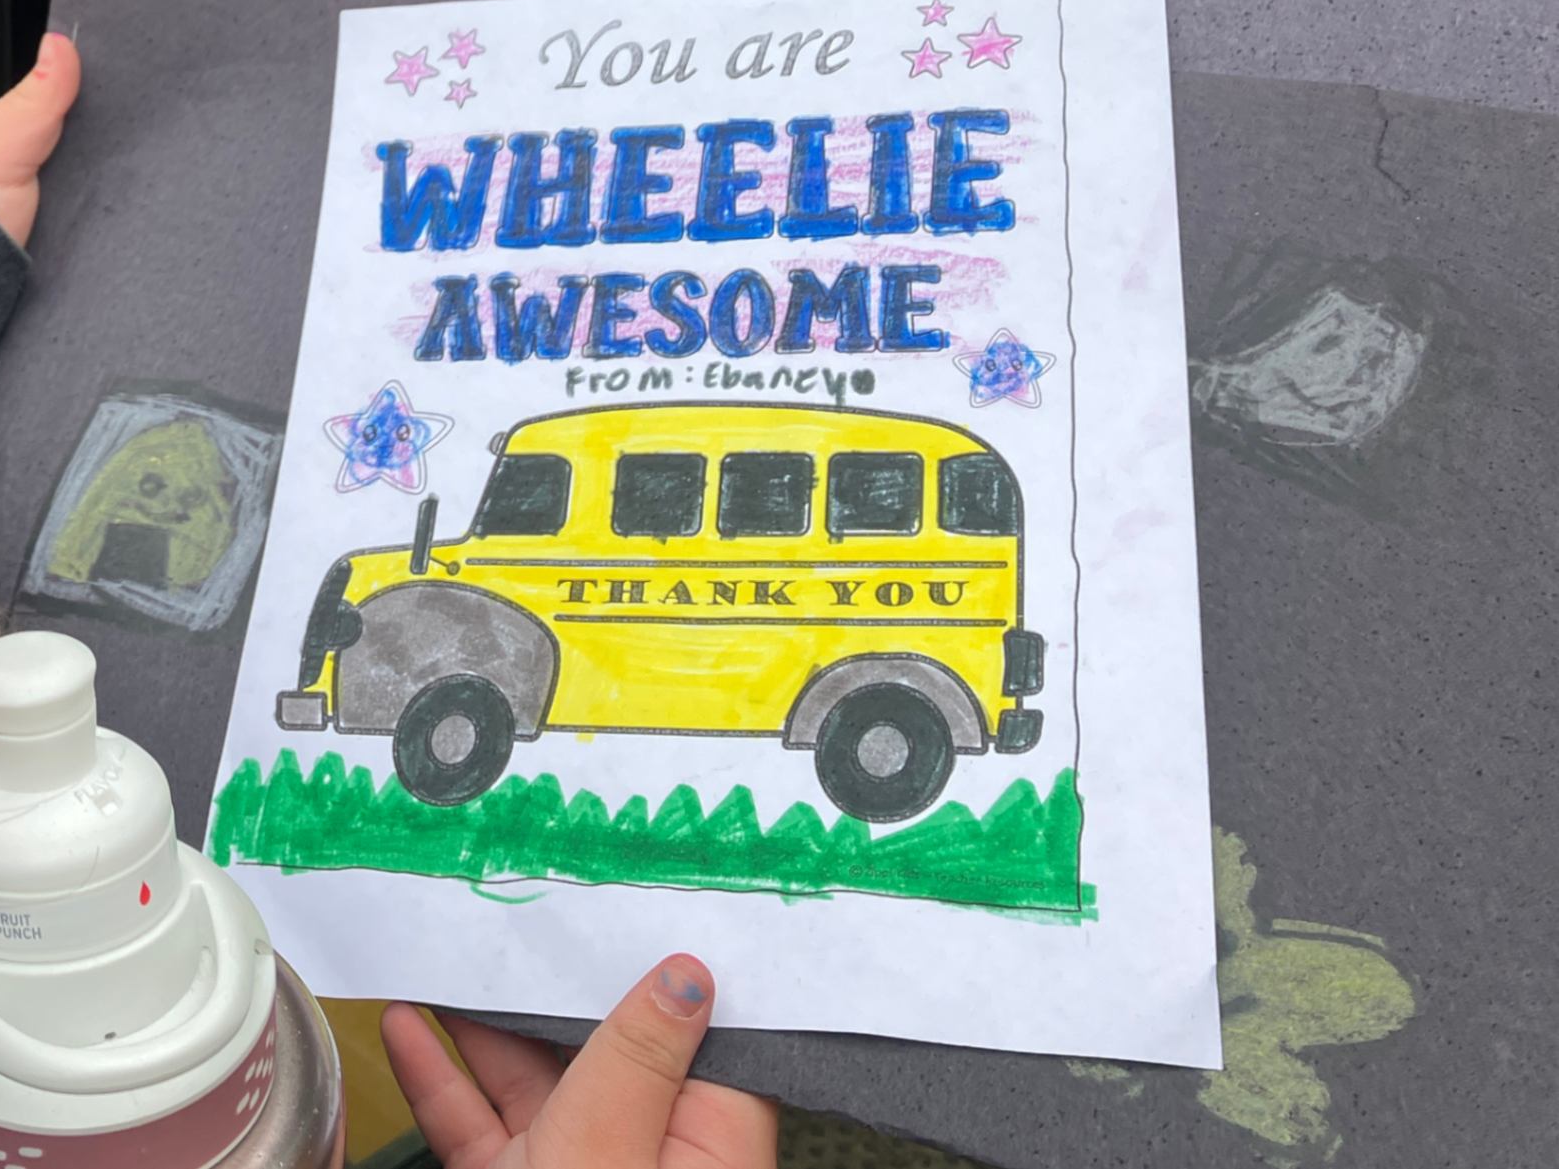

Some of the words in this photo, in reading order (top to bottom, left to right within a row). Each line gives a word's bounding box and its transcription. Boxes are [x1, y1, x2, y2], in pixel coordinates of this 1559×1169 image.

[541, 19, 699, 91] You
[726, 28, 854, 79] are
[376, 108, 1015, 252] WHEELIE
[413, 264, 951, 364] AWESOME
[557, 579, 797, 607] THANK
[826, 580, 970, 607] YOU
